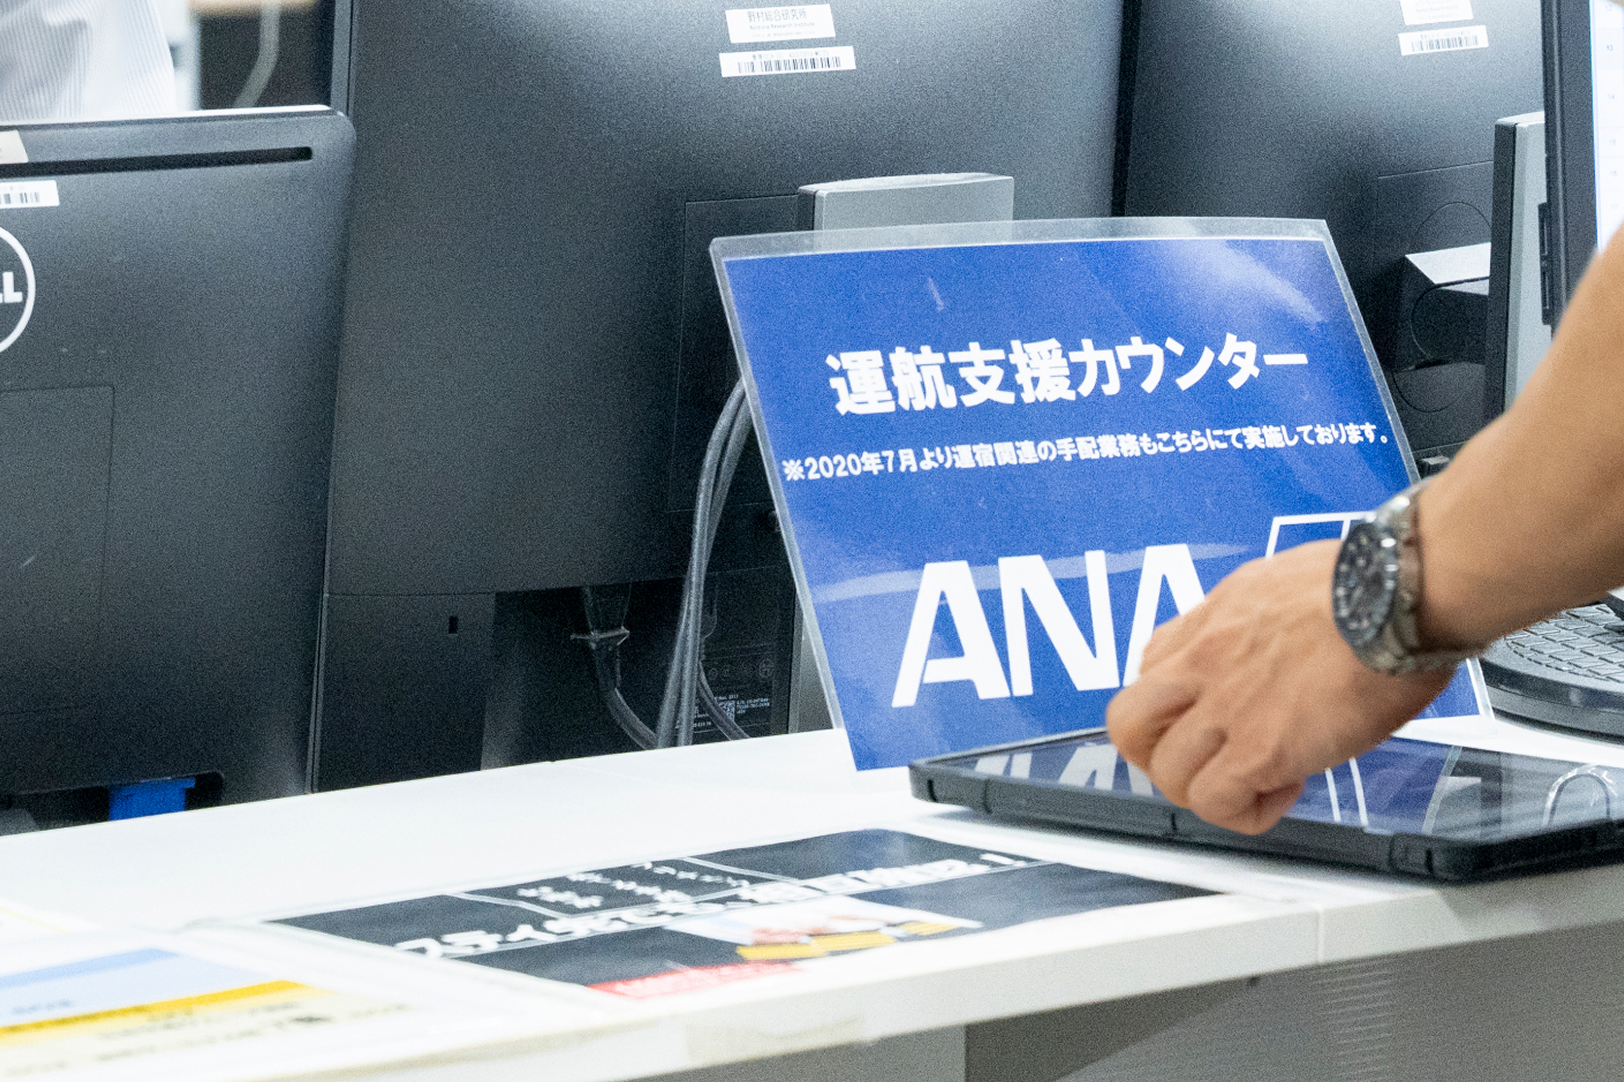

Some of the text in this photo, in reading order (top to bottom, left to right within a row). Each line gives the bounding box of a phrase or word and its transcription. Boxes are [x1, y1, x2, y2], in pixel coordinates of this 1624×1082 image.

[826, 332, 1308, 416] 運航支援カウンター
